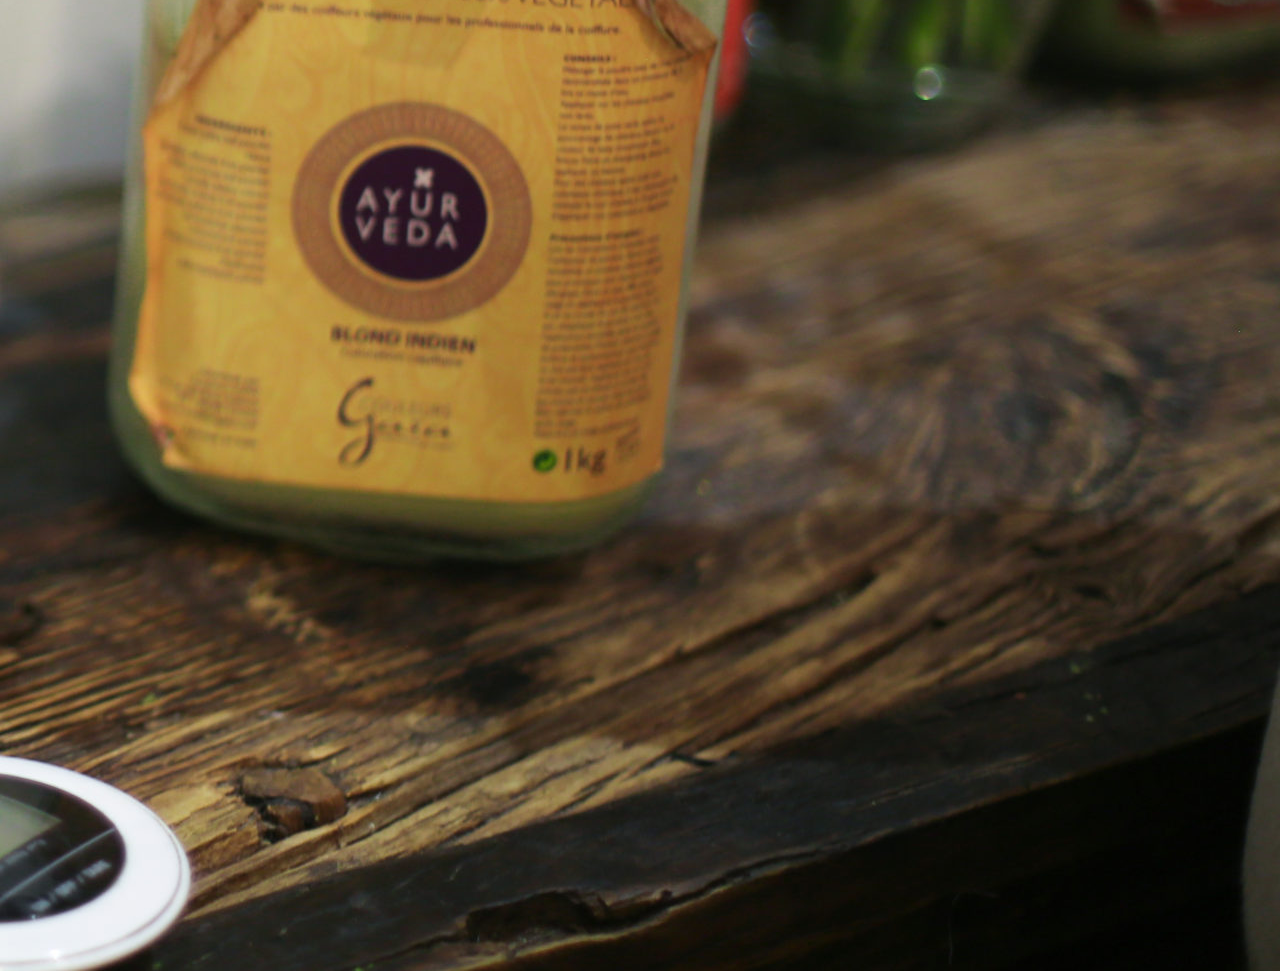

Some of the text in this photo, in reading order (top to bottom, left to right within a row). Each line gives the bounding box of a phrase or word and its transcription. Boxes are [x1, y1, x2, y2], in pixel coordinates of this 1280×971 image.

[355, 186, 460, 221] AYUR
[354, 215, 459, 250] VEDA
[330, 325, 477, 354] BLOND INDIEN
